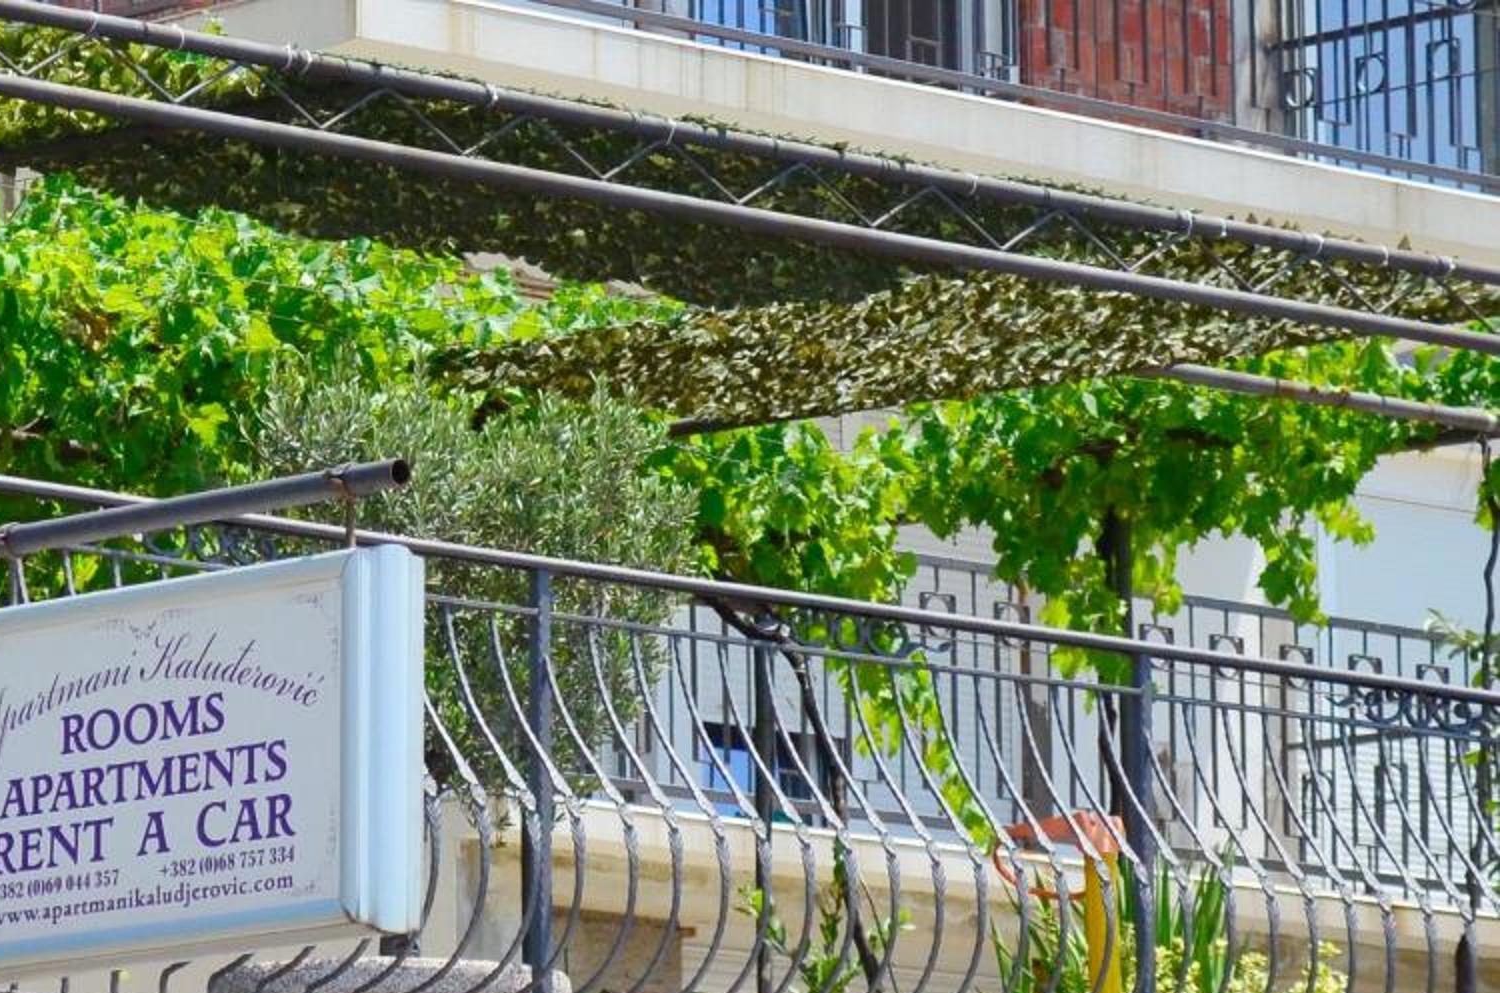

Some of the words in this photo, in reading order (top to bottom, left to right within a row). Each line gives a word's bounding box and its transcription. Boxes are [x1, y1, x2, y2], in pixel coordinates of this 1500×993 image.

[60, 692, 225, 755] ROOMS
[0, 739, 289, 819] APARTMENTS
[137, 811, 170, 857] A
[197, 793, 296, 848] CAR
[65, 873, 91, 891] 044
[94, 868, 120, 888] 357
[159, 857, 196, 878] +382
[240, 848, 266, 868] 757
[269, 845, 296, 865] 334
